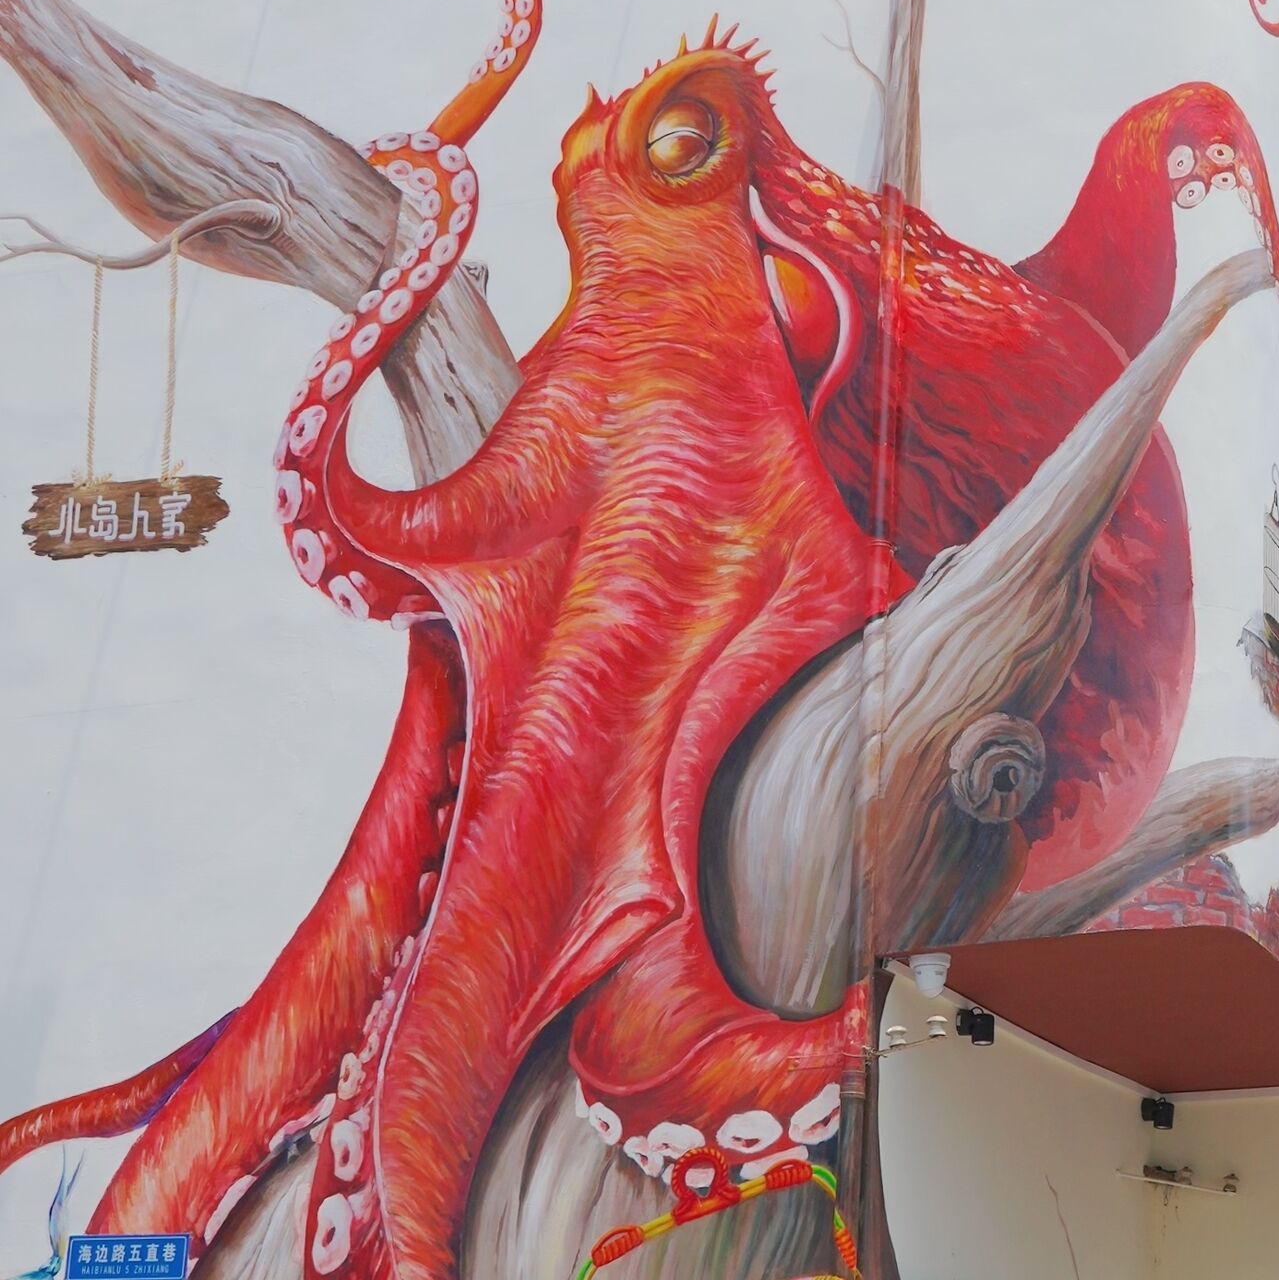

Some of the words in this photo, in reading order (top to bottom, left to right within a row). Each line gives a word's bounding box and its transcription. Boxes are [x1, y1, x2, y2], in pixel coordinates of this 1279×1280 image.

[48, 491, 192, 544] 小岛人家
[78, 1243, 176, 1263] 海边路五直巷
[82, 1265, 121, 1274] HAIBIANLU
[134, 1264, 169, 1274] ZHIXIANG
